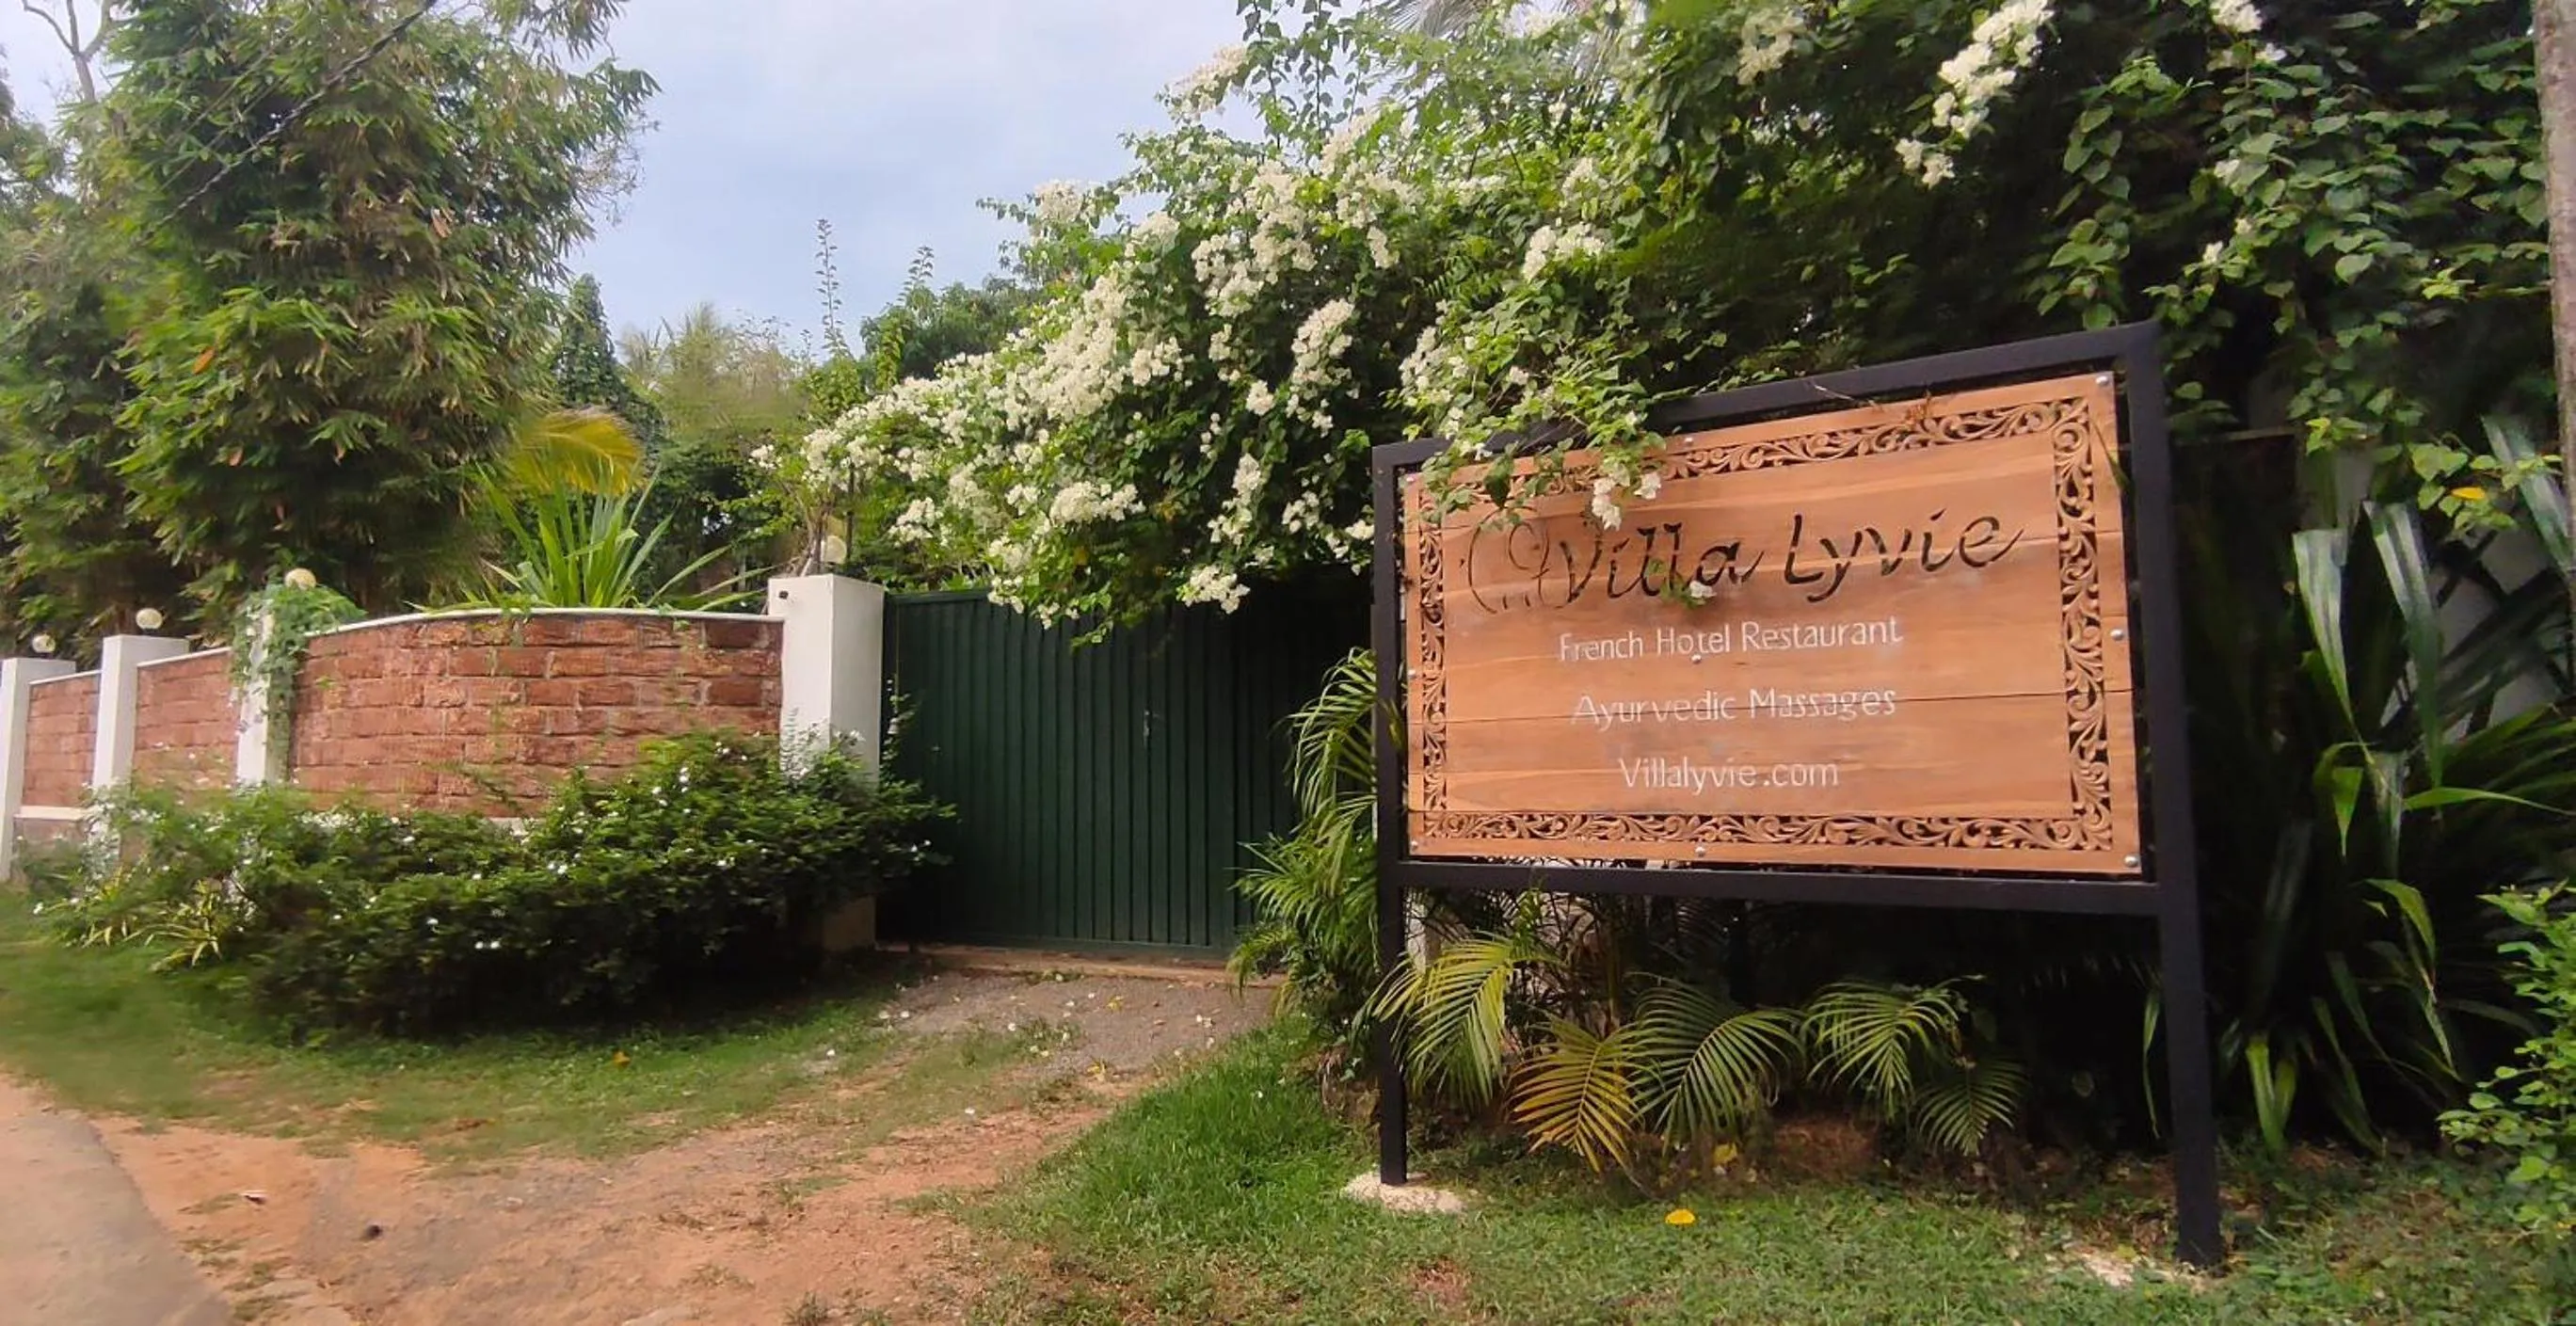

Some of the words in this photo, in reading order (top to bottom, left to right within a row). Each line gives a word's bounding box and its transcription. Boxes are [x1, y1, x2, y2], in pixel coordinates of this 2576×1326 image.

[1555, 520, 1766, 606] Villa
[1784, 507, 2025, 604] Lyvie
[1560, 631, 1644, 663] French
[1656, 624, 1731, 656] Hotel
[1741, 615, 1904, 653] Restaurant
[1570, 690, 1737, 733] Ayurvedic
[1749, 688, 1897, 723] Massages
[1618, 756, 1840, 797] Villalyvie.com
